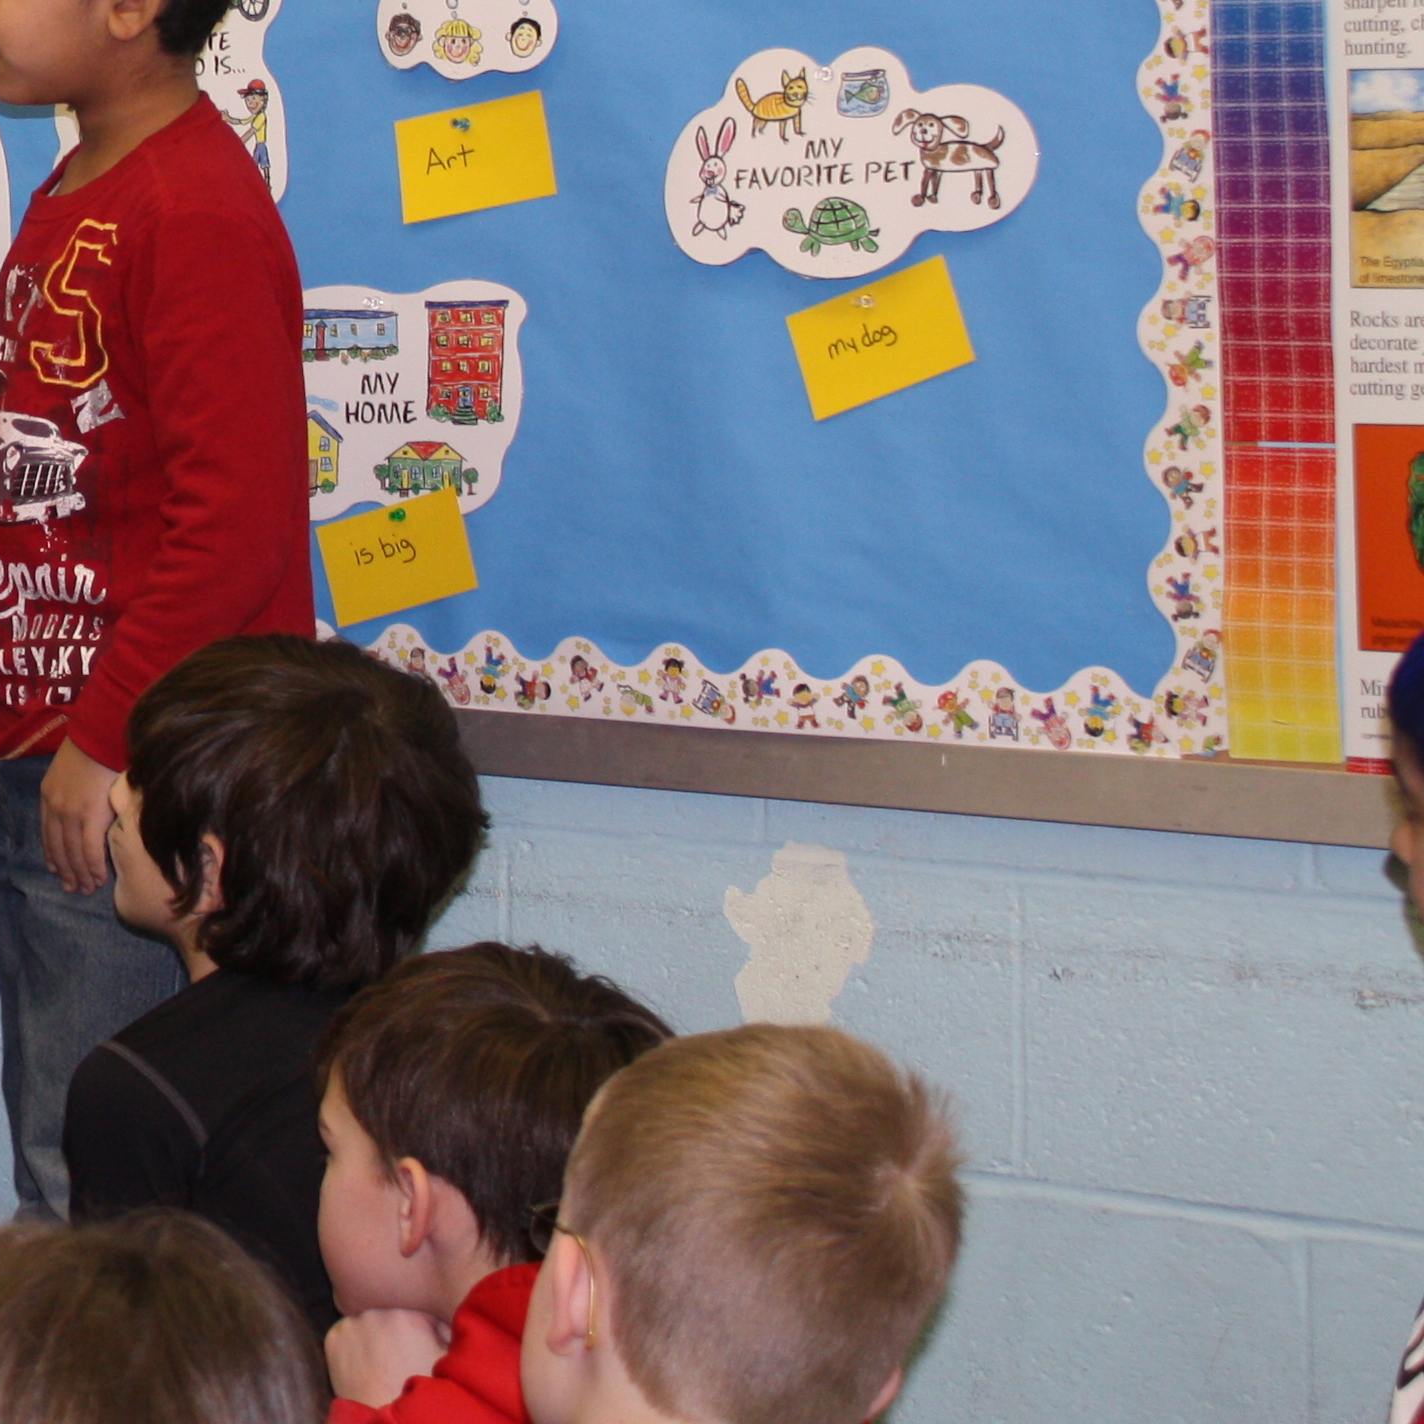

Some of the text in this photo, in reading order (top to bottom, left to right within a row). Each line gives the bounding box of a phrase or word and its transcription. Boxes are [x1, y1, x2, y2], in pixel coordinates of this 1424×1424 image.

[805, 137, 844, 159] MY
[426, 144, 475, 175] Art
[735, 161, 915, 189] FAVORITE PET
[1350, 311, 1399, 327] Rocks
[828, 323, 898, 360] my dog
[1350, 334, 1417, 350] decorate
[1350, 357, 1407, 373] hardest
[361, 373, 399, 395] MY
[1350, 380, 1404, 400] cutting
[345, 402, 417, 424] HOME
[350, 534, 417, 566] is big
